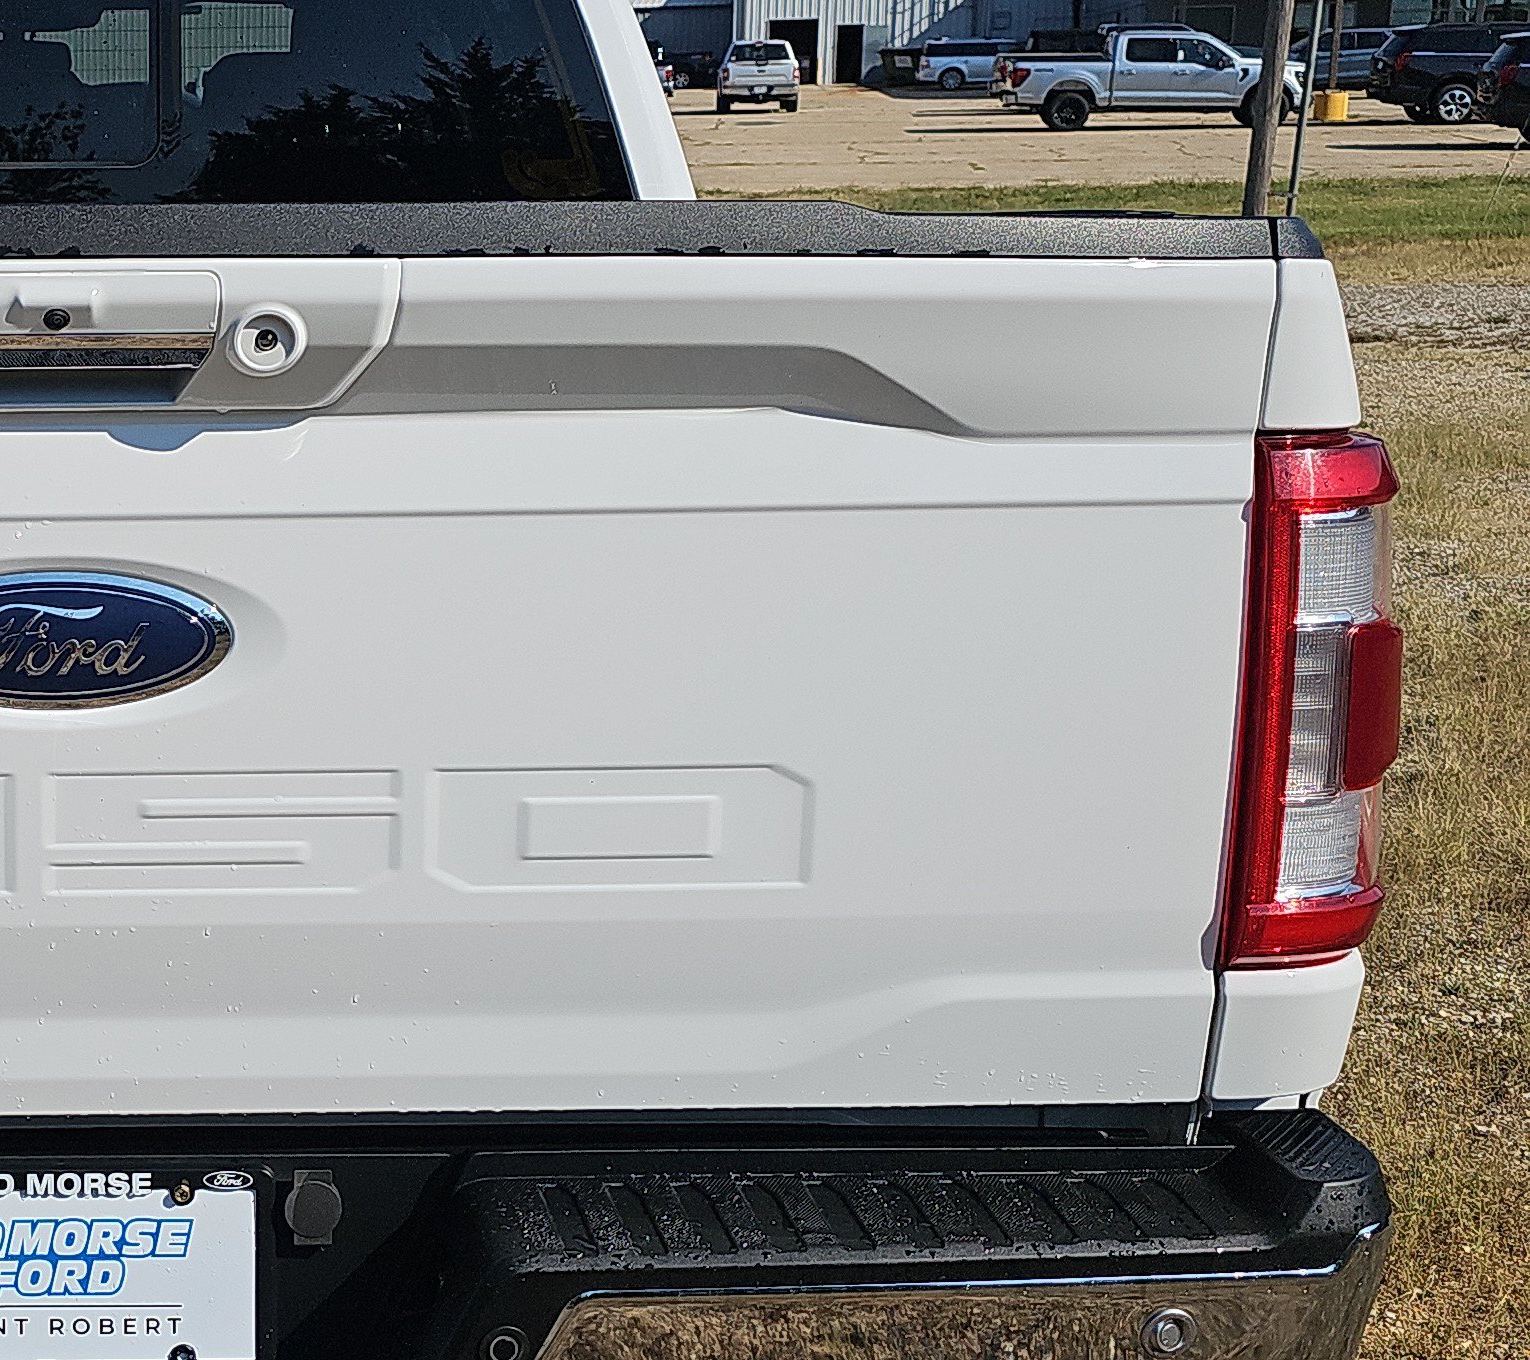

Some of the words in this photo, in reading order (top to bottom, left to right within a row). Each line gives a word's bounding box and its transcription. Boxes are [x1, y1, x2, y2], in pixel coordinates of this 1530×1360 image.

[26, 1172, 152, 1196] MORSE
[5, 1217, 195, 1259] MORSE
[48, 1316, 183, 1335] ROBERT
